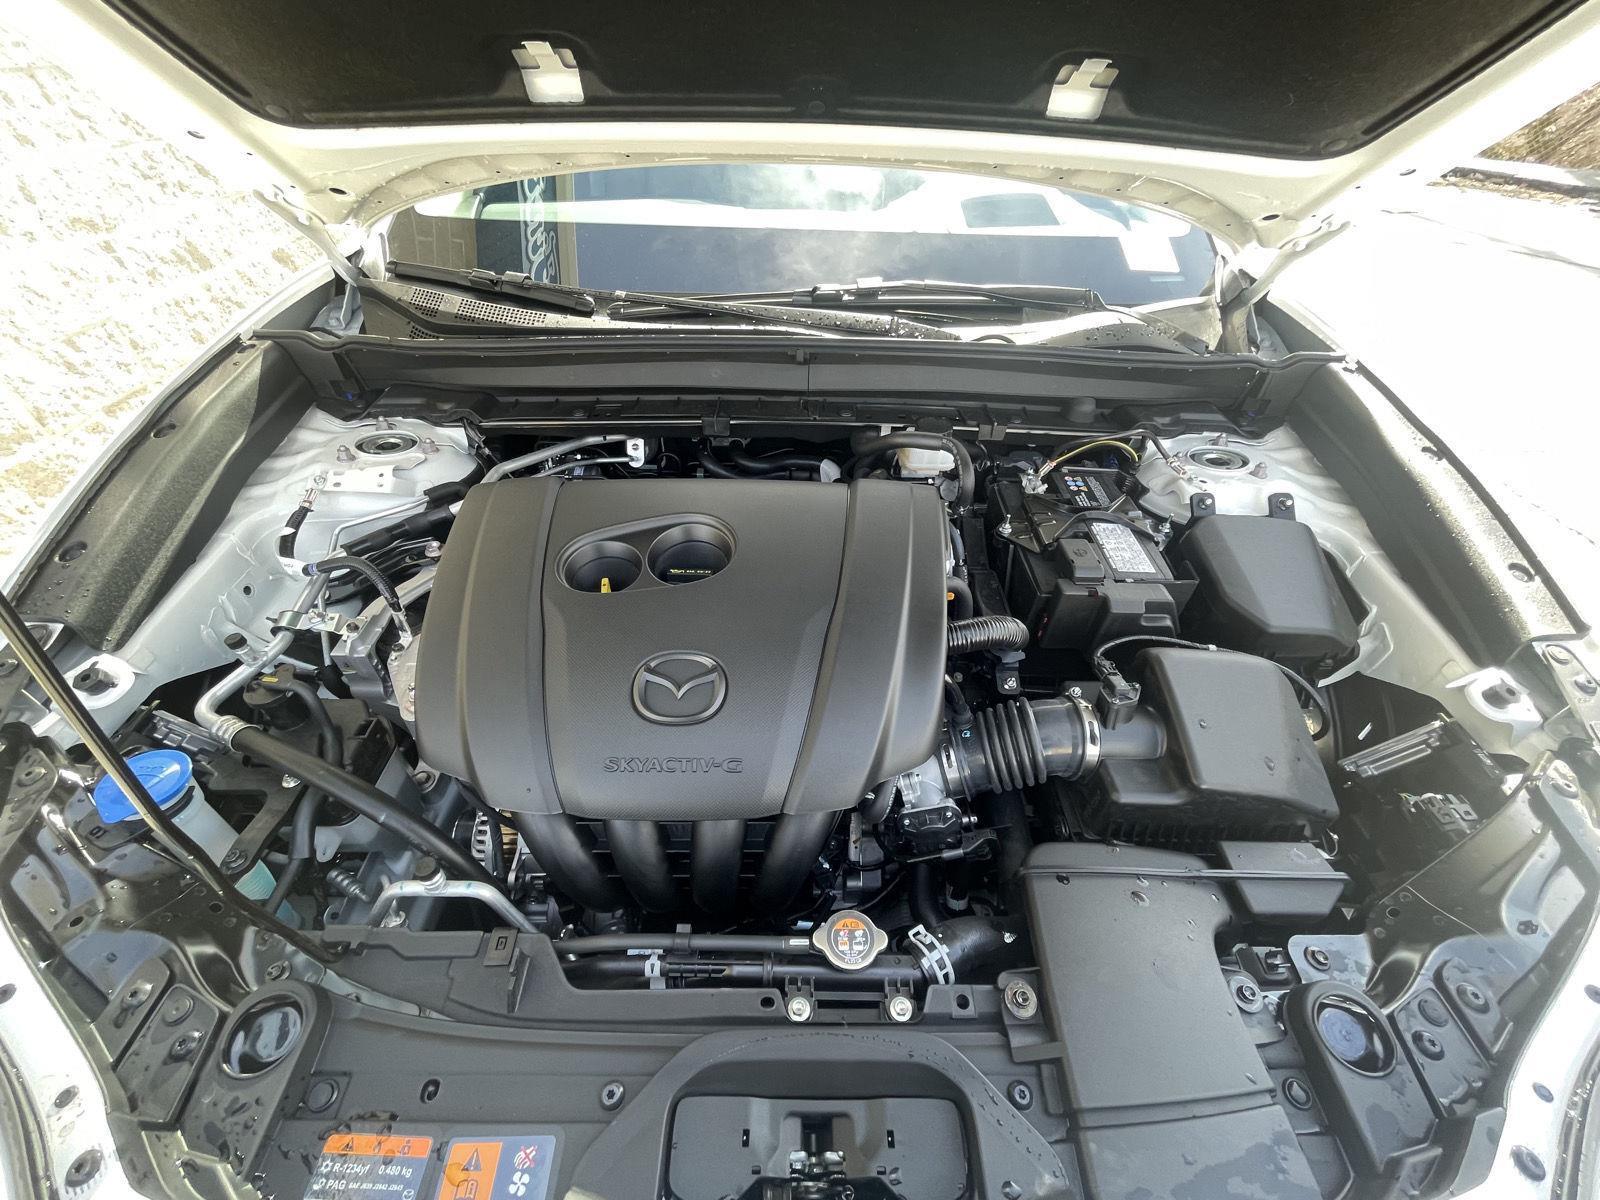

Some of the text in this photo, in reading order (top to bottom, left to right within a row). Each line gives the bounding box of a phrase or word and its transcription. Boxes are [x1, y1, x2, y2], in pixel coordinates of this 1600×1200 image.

[603, 756, 744, 773] SKYACTIV-G
[332, 1163, 413, 1178] R-1234yf 0.480 kg
[326, 1179, 346, 1190] PAG
